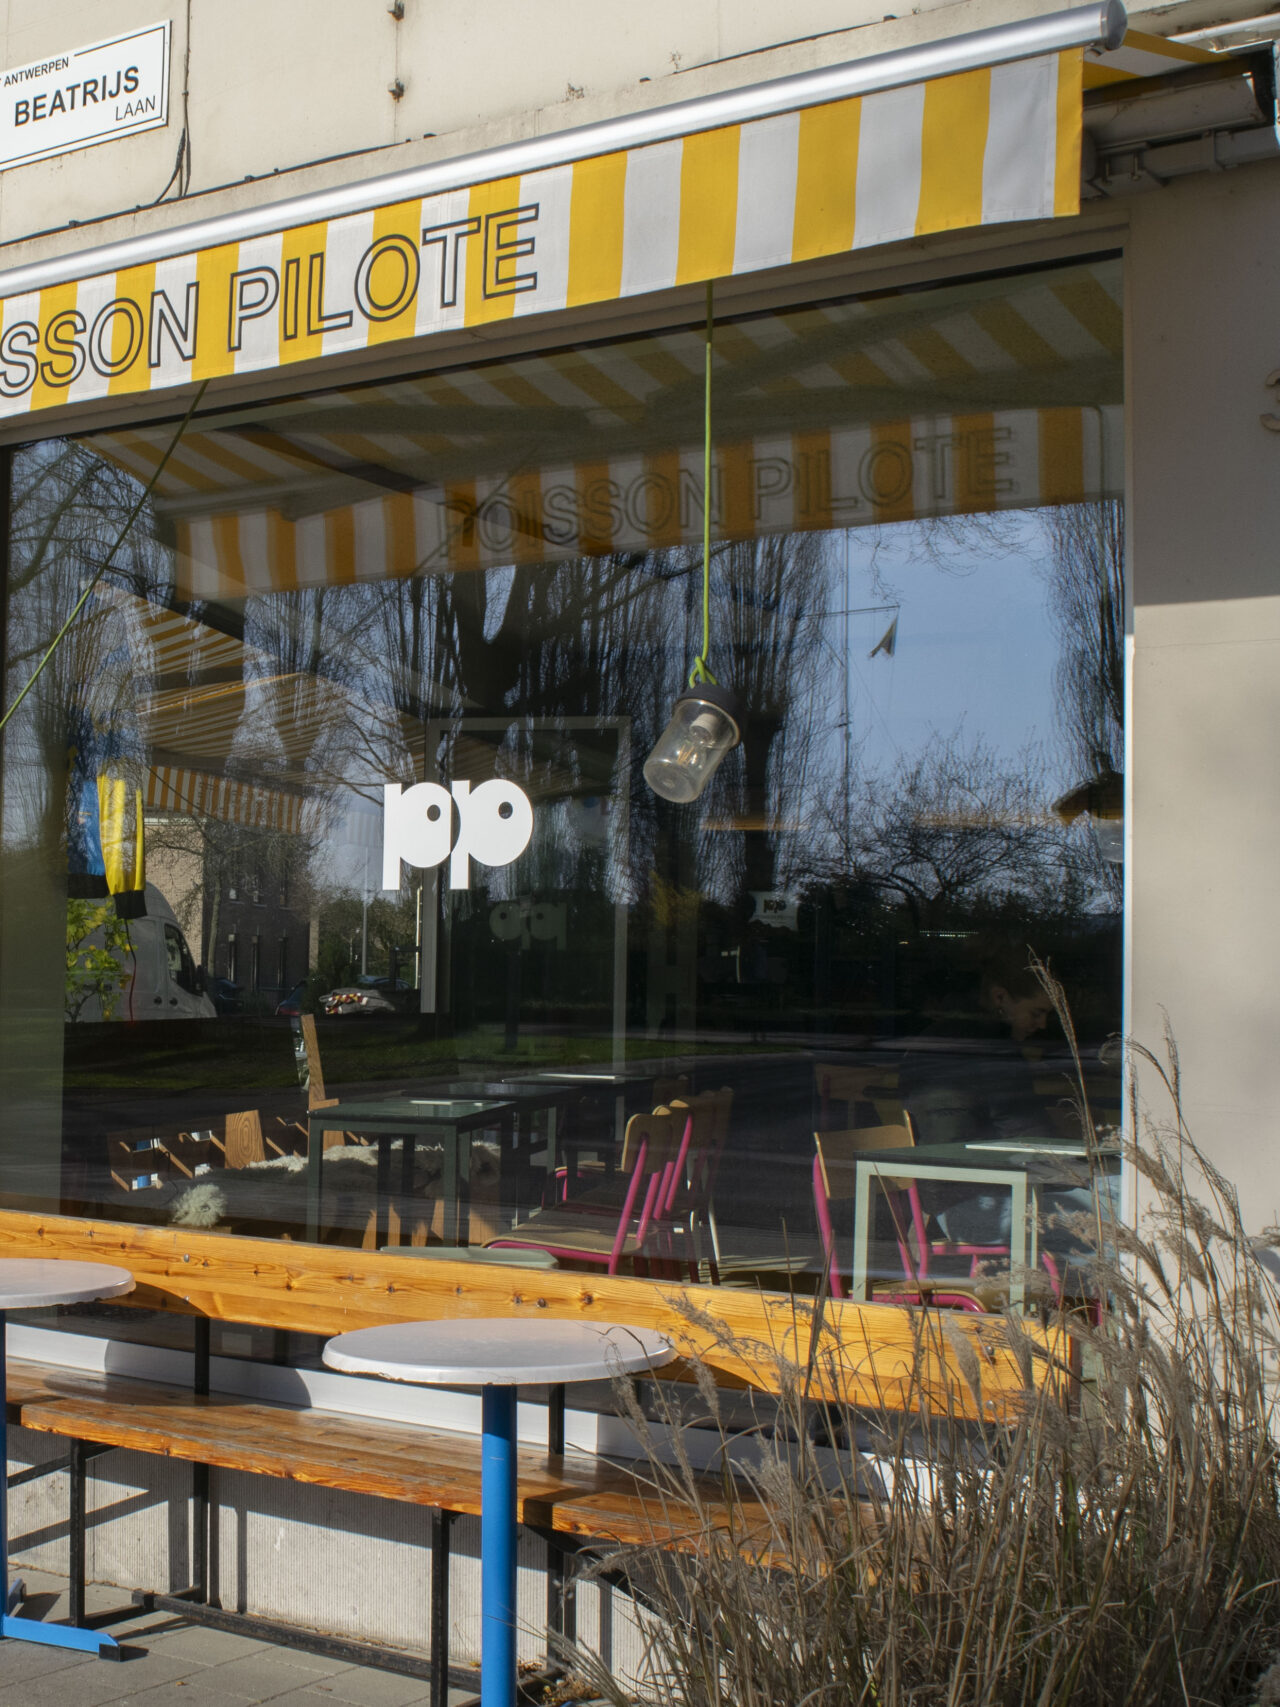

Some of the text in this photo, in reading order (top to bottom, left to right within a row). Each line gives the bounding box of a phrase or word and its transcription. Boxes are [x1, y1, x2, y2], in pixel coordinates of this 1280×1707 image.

[4, 57, 69, 87] ANTWERPEN
[14, 65, 139, 127] BEATRIJS
[115, 95, 156, 121] LAAN
[227, 203, 540, 352] PILOTE
[751, 427, 1014, 520] PILOTE
